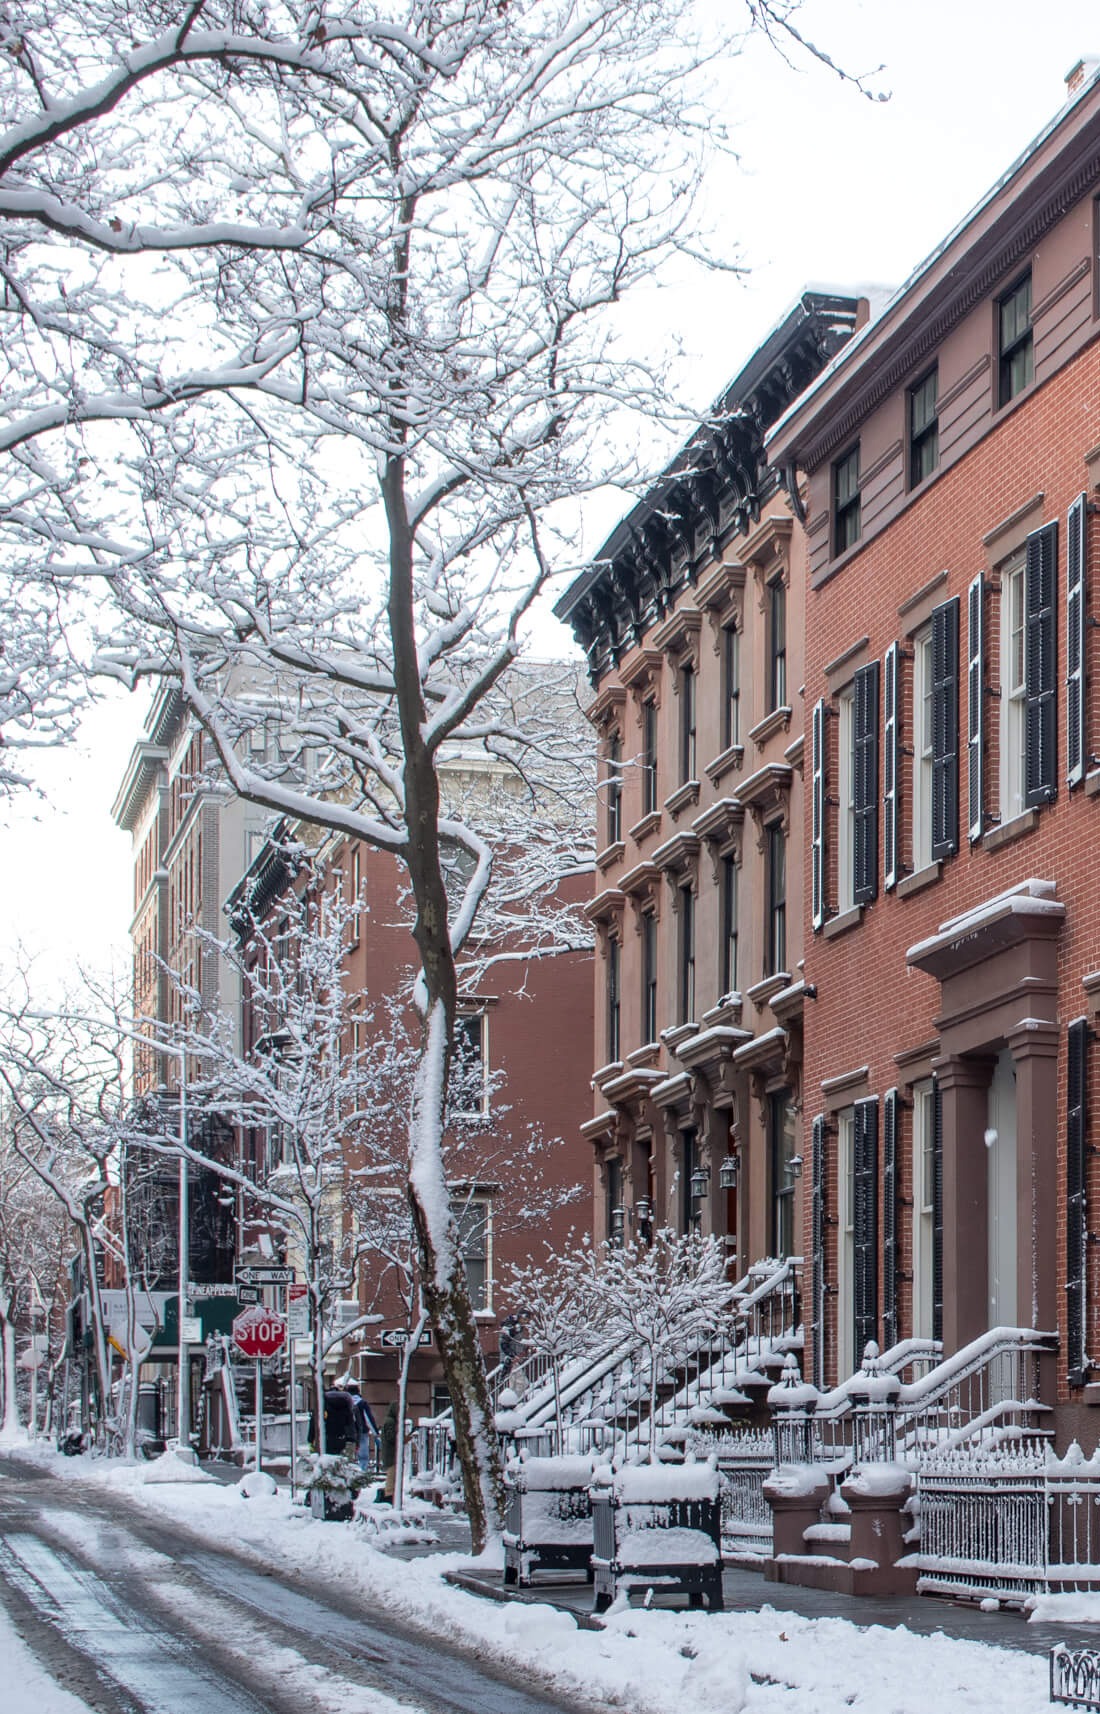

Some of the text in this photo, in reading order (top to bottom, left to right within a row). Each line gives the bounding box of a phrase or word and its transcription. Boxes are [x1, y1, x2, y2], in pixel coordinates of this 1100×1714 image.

[242, 1271, 290, 1280] ONE WAY
[236, 1322, 283, 1342] STOP
[390, 1334, 404, 1342] ONE
